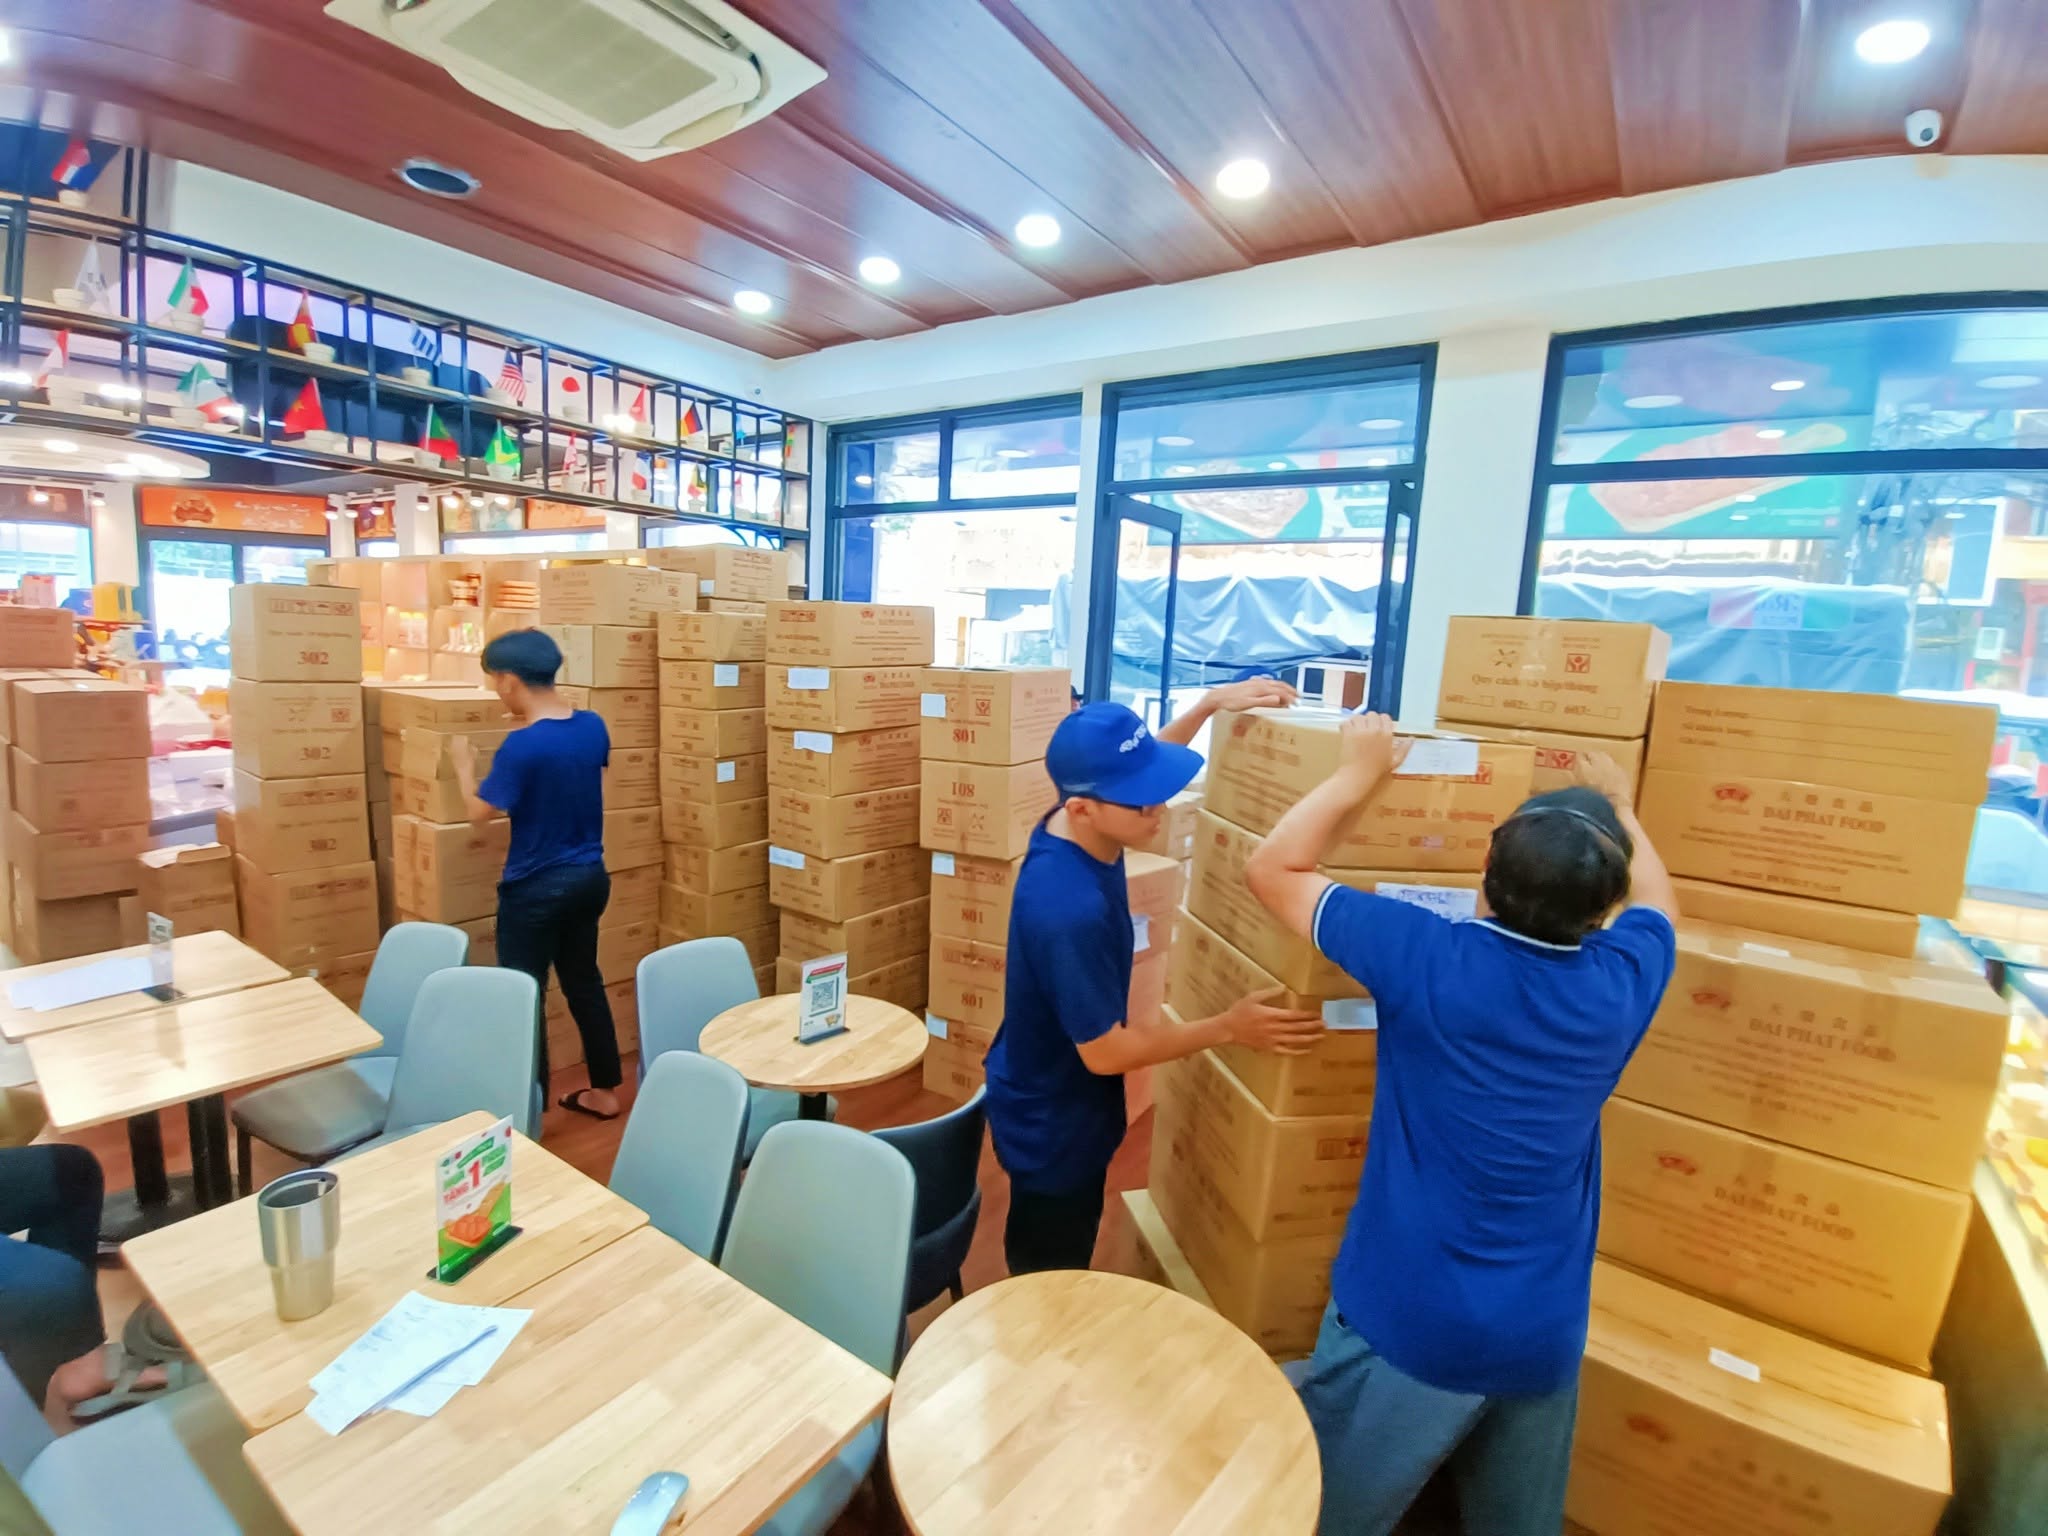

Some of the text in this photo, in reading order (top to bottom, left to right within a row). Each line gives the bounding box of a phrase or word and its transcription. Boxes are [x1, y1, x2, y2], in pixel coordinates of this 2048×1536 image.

[953, 729, 976, 744] 801
[961, 908, 984, 924] 801
[961, 993, 984, 1009] 801
